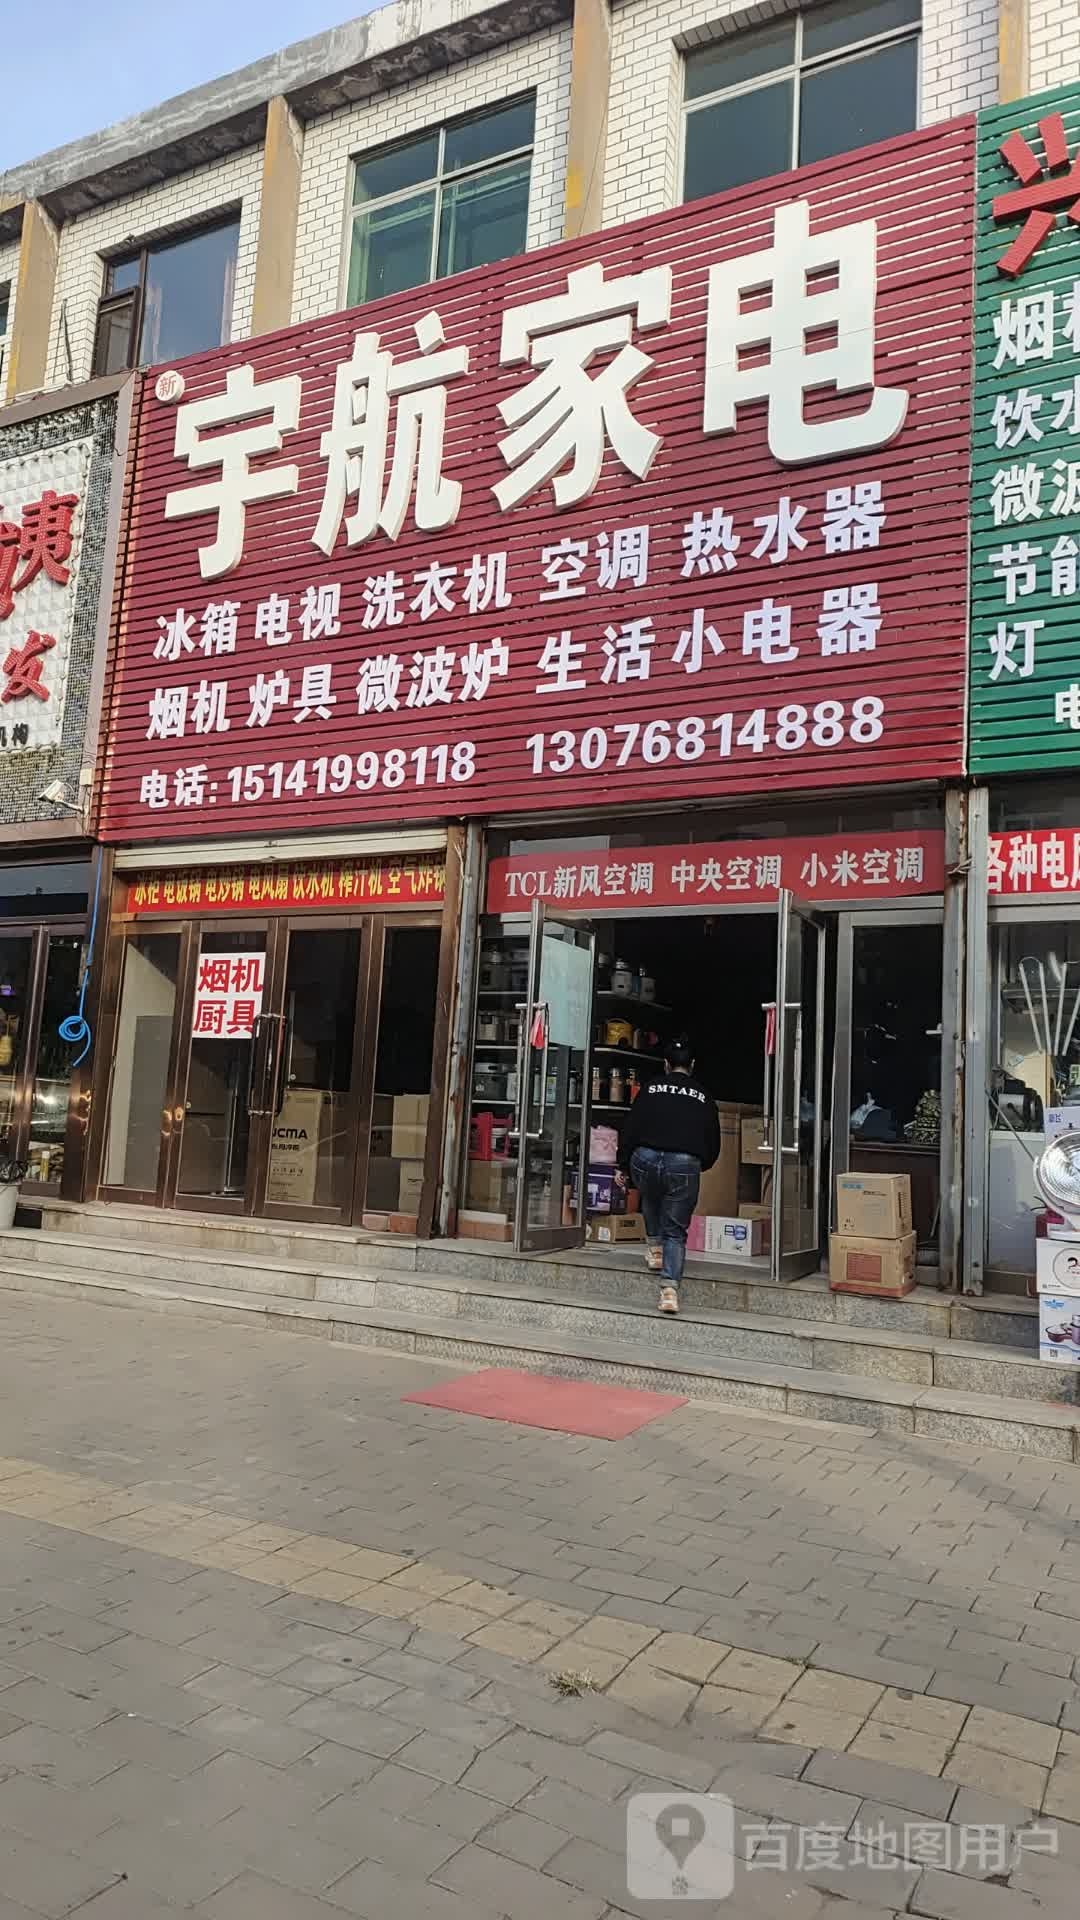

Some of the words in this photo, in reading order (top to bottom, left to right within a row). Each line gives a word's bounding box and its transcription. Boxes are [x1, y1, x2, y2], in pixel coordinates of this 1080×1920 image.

[158, 375, 177, 398] 新
[165, 199, 909, 581] 宇航家电
[153, 600, 241, 661] 冰箱
[255, 583, 341, 646] 电视
[361, 552, 512, 629] 洗衣机
[538, 523, 650, 602] 空调
[680, 480, 887, 577] 热水器
[145, 680, 230, 740] 烟机
[245, 664, 336, 727] 炉具
[356, 637, 509, 714] 微波炉
[536, 583, 883, 693] 生活小电器
[988, 619, 1045, 680] 灯
[526, 696, 884, 773] 13076814888
[505, 861, 655, 899] TCL新风空调
[671, 855, 783, 894] 中央空调
[801, 846, 924, 888] 小米空调
[198, 958, 263, 993] 烟机
[193, 1000, 254, 1035] 厨具
[648, 1084, 706, 1103] SMTAER
